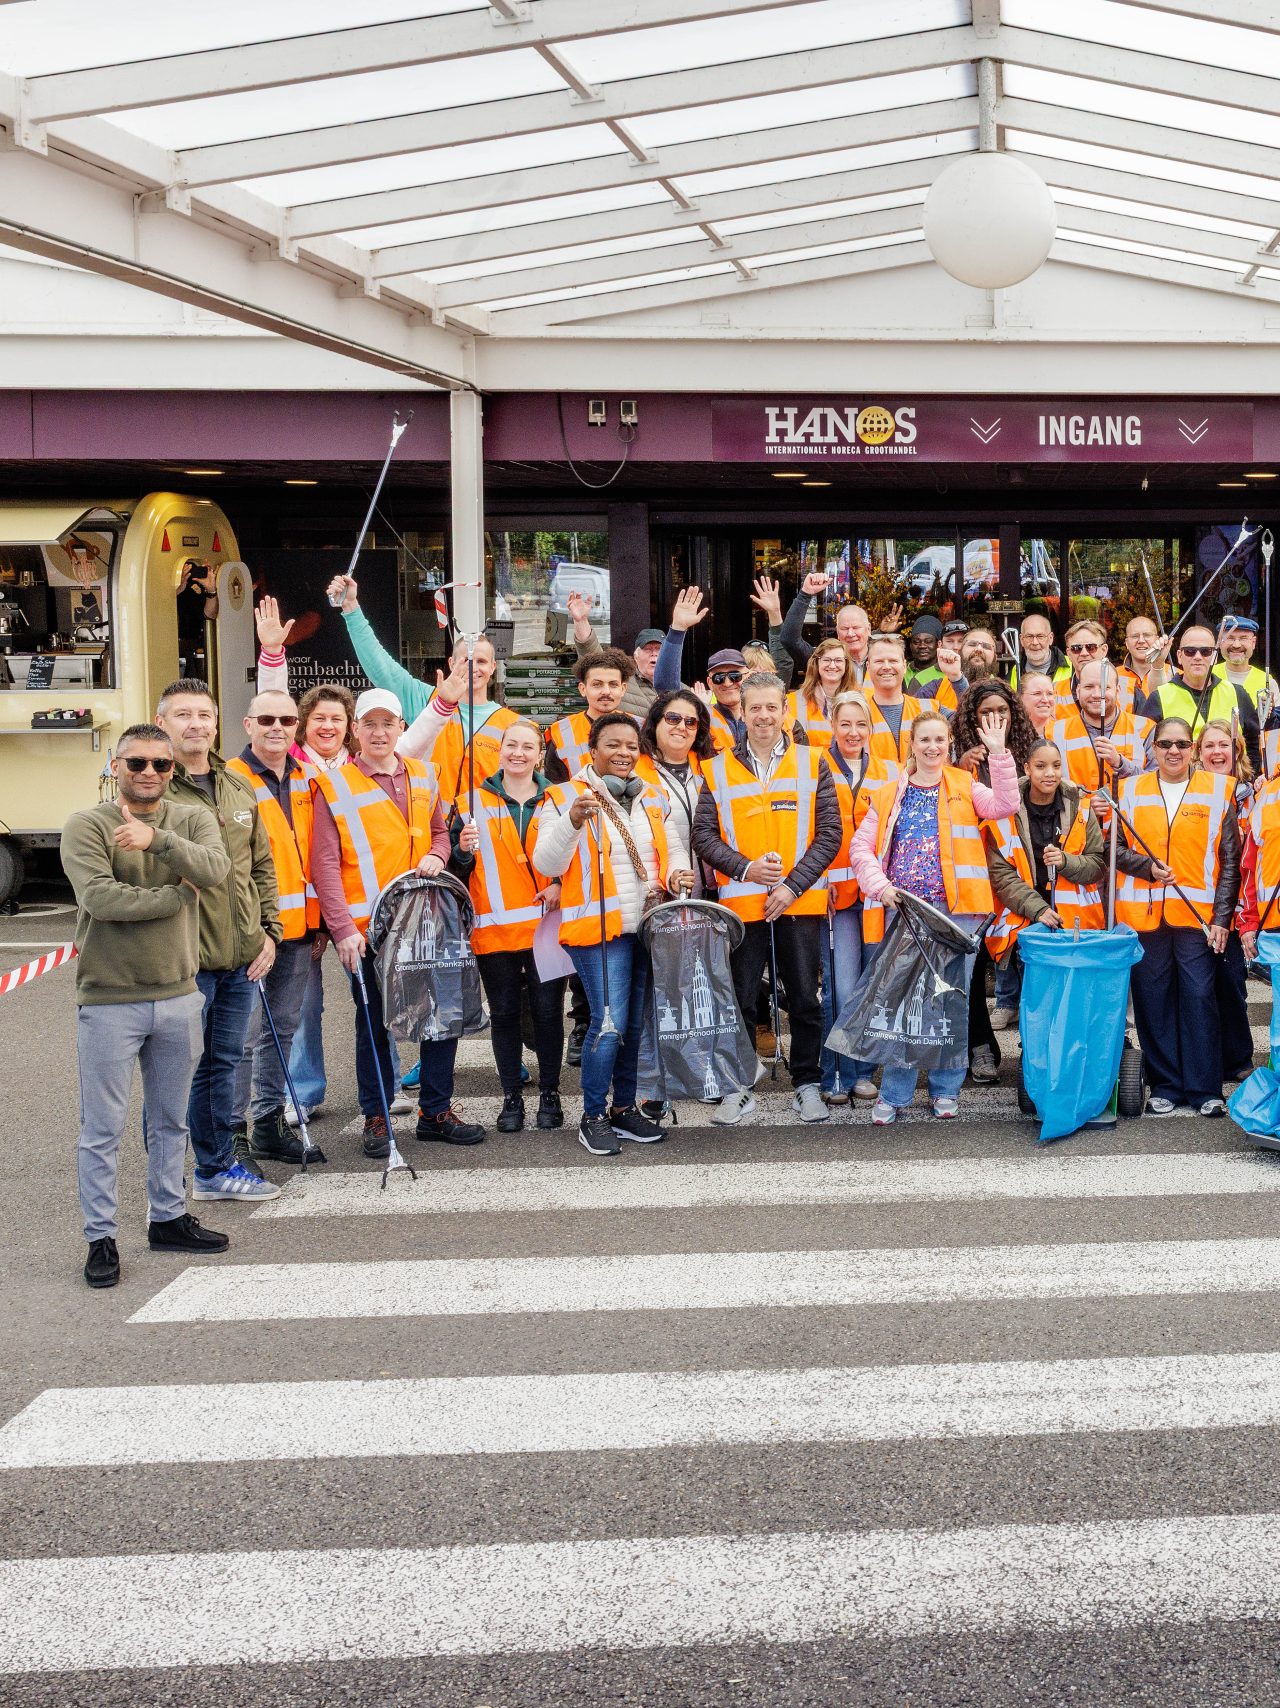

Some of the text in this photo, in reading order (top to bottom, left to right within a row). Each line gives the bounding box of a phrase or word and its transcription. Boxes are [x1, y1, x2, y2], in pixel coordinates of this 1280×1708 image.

[765, 406, 917, 445] HANOS
[1039, 415, 1142, 446] INGANG
[765, 446, 918, 454] INTERNATIONALE HORECA GROOTHANDEL
[287, 656, 311, 664] waar
[288, 660, 363, 676] ambacht
